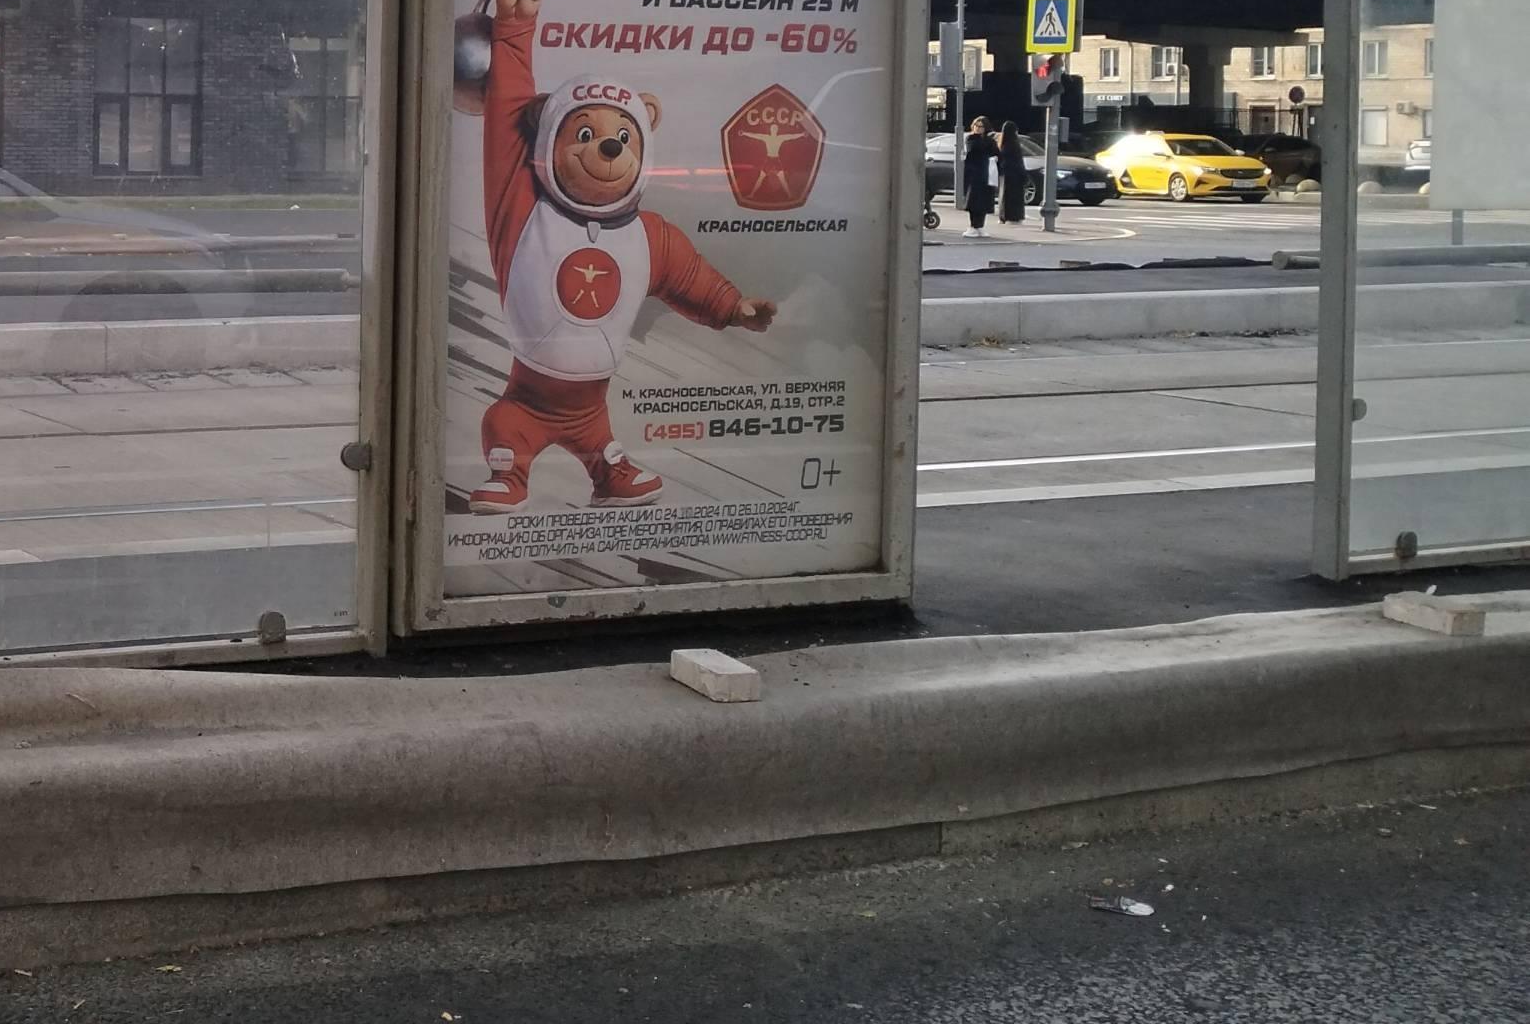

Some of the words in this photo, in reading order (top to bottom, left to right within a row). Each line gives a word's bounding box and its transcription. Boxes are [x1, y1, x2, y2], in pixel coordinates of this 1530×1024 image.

[540, 22, 694, 54] СКИДКИ
[701, 25, 755, 56] ДО
[765, 23, 858, 55] -60%
[697, 218, 848, 234] КРАСНОСЕЛЬСКАЯ
[622, 389, 636, 400] М.
[639, 385, 757, 399] КРАСНОСЕЛЬСКАЯ,
[761, 382, 781, 396] УЛ.
[785, 381, 846, 394] ВЕРХНЯЯ
[633, 398, 767, 415] КРАСНОСЕЛЬСКАЯ,
[808, 395, 845, 408] СТР.2
[644, 421, 704, 442] (495)
[709, 414, 845, 438] 846-10-75
[801, 457, 842, 490] 0+
[448, 532, 529, 547] ИНФОРМАЦИЮ
[530, 529, 546, 543] ОБ
[546, 525, 628, 542] ОРГАНИЗАТОРЕ
[704, 519, 713, 532] О
[713, 516, 768, 532] ПРАВИЛАХ
[768, 514, 787, 528] ЕГО
[787, 511, 853, 527] ПРОВЕДЕНИЯ
[507, 516, 544, 529] СРОКИ
[545, 511, 616, 527] ПРОВЕДЕНИЯ
[617, 509, 653, 523] АКЦИИ
[653, 508, 663, 521] С
[721, 504, 737, 517] ПО
[478, 546, 522, 560] МОЖНО
[522, 542, 579, 558] ПОЛУЧИТЬ
[580, 541, 595, 553] НА
[596, 537, 633, 553] САЙТЕ
[633, 533, 710, 550] ОРГАНИЗАТОРА
